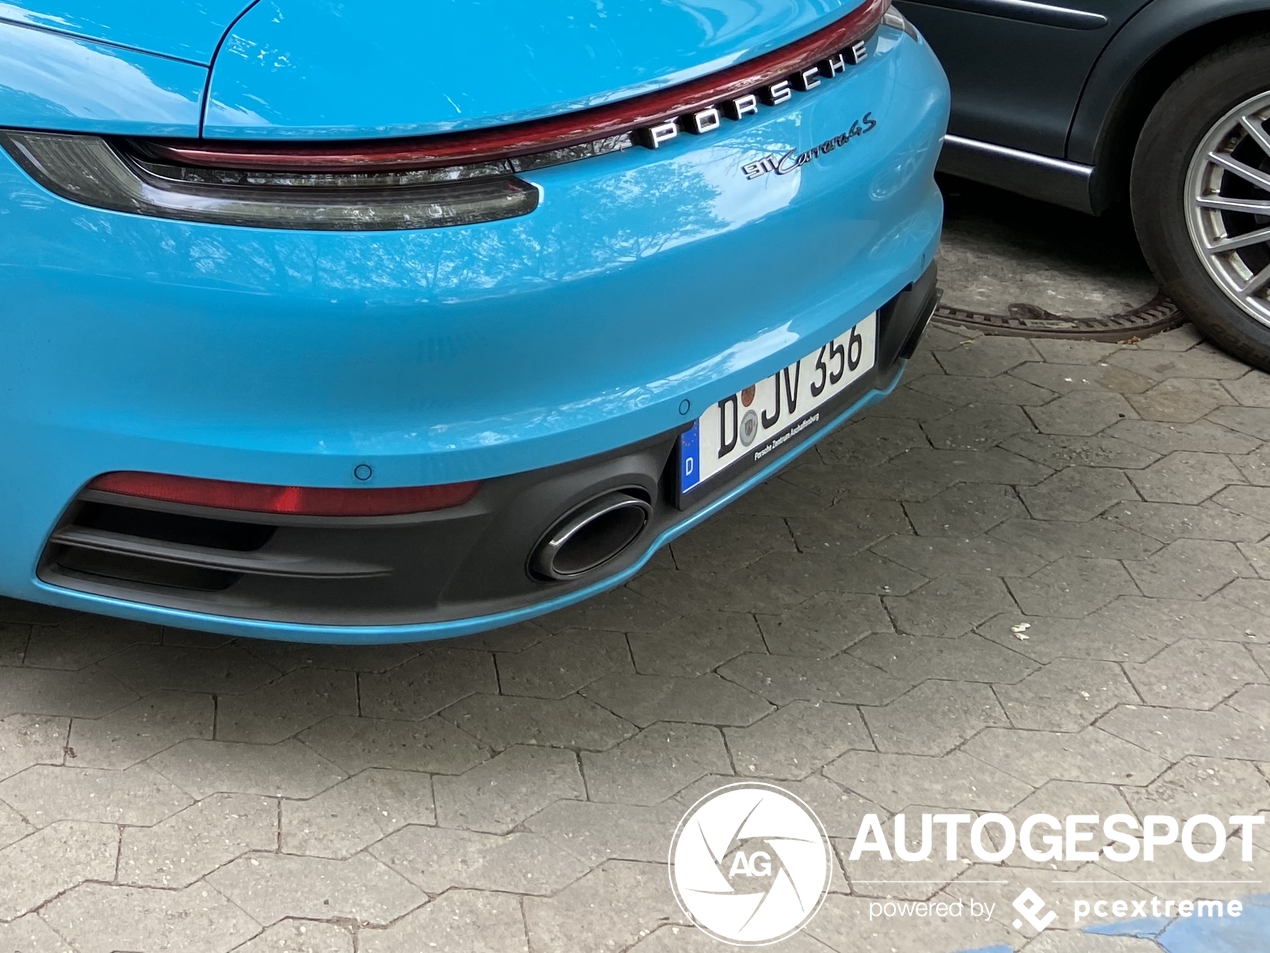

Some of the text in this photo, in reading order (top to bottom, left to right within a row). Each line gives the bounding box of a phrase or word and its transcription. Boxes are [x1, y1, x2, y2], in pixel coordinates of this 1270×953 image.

[649, 40, 867, 149] PORSCHE
[741, 153, 778, 180] 911
[776, 132, 849, 175] Carrera
[718, 325, 862, 459] D JV 356
[755, 413, 820, 461] Porsche Zentrum Aschaffenburg
[685, 456, 694, 476] D
